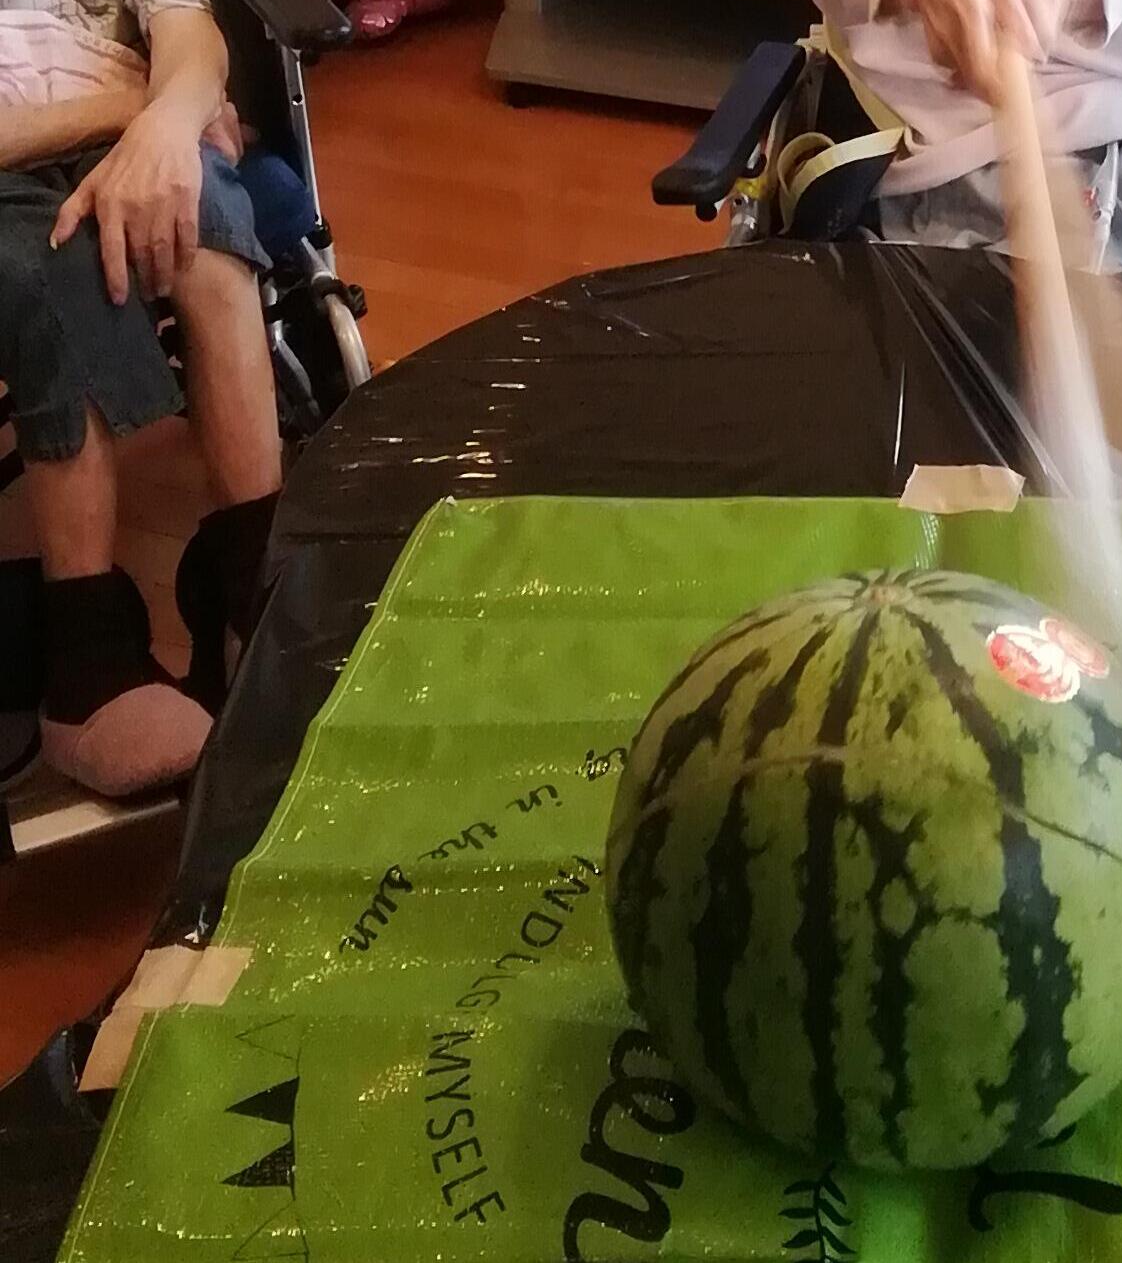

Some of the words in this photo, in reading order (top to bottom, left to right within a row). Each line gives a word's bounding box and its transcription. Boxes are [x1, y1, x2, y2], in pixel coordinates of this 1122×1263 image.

[505, 784, 562, 813] in
[418, 822, 497, 861] the
[339, 864, 413, 953] sun
[424, 1029, 506, 1222] MYSELF
